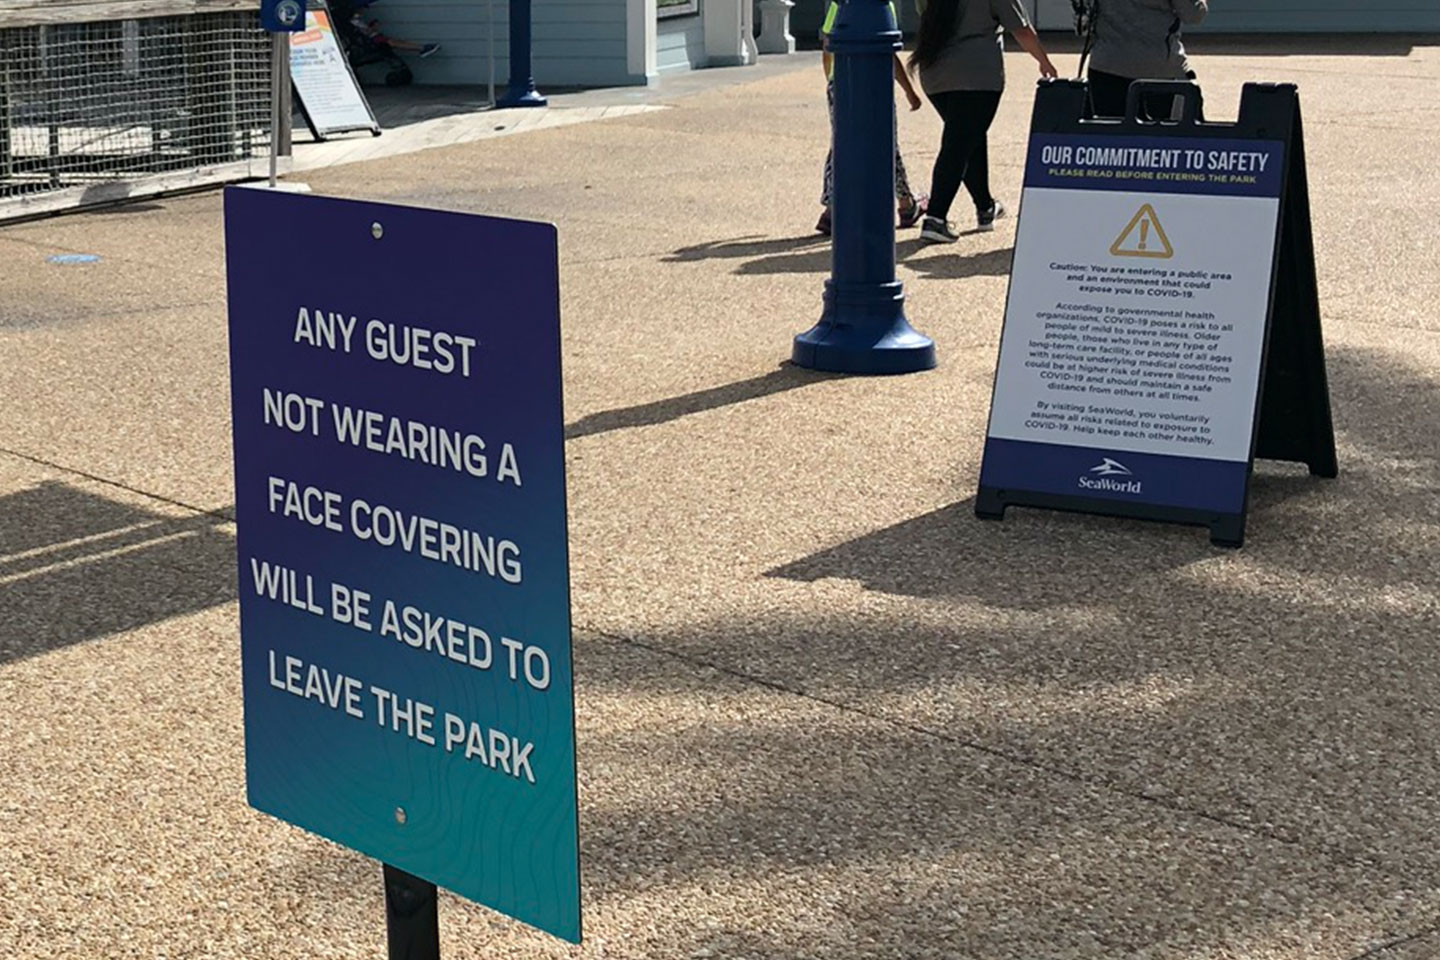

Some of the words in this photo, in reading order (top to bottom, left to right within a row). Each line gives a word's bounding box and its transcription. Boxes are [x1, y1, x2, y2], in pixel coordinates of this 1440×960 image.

[1041, 145, 1072, 164] OUR
[1075, 146, 1182, 168] COMMITMENT
[1184, 150, 1204, 169] TO
[1207, 150, 1269, 172] SAFETY
[1048, 168, 1084, 177] PLEASE
[1086, 169, 1113, 178] READ
[1115, 170, 1154, 179] BEFORE
[1156, 171, 1206, 182] ENTERING
[1208, 173, 1227, 182] THE
[1229, 174, 1256, 183] PARK
[1049, 262, 1087, 271] Caution:
[1090, 265, 1108, 273] You
[1127, 268, 1167, 278] entering
[1177, 270, 1208, 279] public
[1066, 274, 1085, 282] and
[1099, 276, 1160, 286] environment
[1161, 279, 1181, 287] that
[1183, 281, 1211, 289] could
[1078, 285, 1112, 293] expose
[1114, 287, 1132, 295] you
[1134, 287, 1145, 295] to
[1055, 302, 1103, 314] According
[1117, 307, 1183, 318] governmental
[1184, 311, 1215, 320] health
[1044, 322, 1077, 331] people
[1091, 325, 1112, 334] mild
[1114, 327, 1124, 335] to
[1126, 328, 1157, 337] severe
[1193, 331, 1221, 341] Older
[1103, 315, 1148, 326] COVID-19
[1149, 320, 1178, 328] poses
[1188, 322, 1205, 330] risk
[294, 307, 357, 353] ANY
[366, 319, 476, 377] GUEST
[1028, 339, 1075, 350] long-term
[1076, 344, 1097, 352] care
[1147, 350, 1180, 359] people
[1182, 352, 1194, 360] of
[1195, 353, 1207, 361] all
[1209, 355, 1232, 363] ages
[1082, 334, 1108, 343] those
[1110, 336, 1131, 345] who
[1132, 338, 1150, 346] live
[1162, 341, 1180, 350] any
[1182, 342, 1205, 351] type
[1206, 343, 1218, 351] of
[1024, 360, 1051, 369] could
[1052, 362, 1065, 370] be
[1066, 363, 1076, 371] at
[1078, 364, 1109, 374] higher
[1130, 368, 1141, 376] of
[1142, 370, 1174, 379] severe
[1175, 372, 1205, 381] illness
[1208, 374, 1231, 383] from
[1051, 353, 1084, 362] serious
[1086, 356, 1137, 367] underlying
[1138, 360, 1177, 369] medical
[1178, 363, 1229, 373] conditions
[1039, 370, 1084, 382] COVID-19
[1106, 377, 1138, 386] should
[1139, 380, 1182, 390] maintain
[1192, 384, 1212, 392] safe
[1047, 382, 1086, 392] distance
[1088, 384, 1111, 394] from
[1113, 388, 1143, 397] others
[1158, 391, 1170, 399] all
[1030, 411, 1065, 421] assume
[1080, 415, 1102, 424] risks
[1104, 417, 1139, 428] related
[1140, 421, 1151, 429] to
[1153, 423, 1198, 433] exposure
[1199, 426, 1211, 434] to
[1036, 400, 1050, 410] By
[1051, 403, 1085, 413] visiting
[1158, 412, 1210, 425] voluntarily
[263, 388, 324, 436] NOT
[331, 403, 488, 477] WEARING
[497, 443, 522, 486] A
[1073, 425, 1095, 434] Help
[1097, 426, 1121, 437] keep
[1122, 430, 1146, 438] each
[1147, 432, 1174, 441] other
[1078, 476, 1141, 493] SeaWorld
[268, 476, 343, 532] FACE
[351, 499, 522, 583] COVERING
[251, 557, 324, 615] WILL
[331, 583, 372, 631] BE
[380, 600, 492, 669] ASKED
[501, 637, 550, 689] TO
[269, 650, 364, 718] LEAVE
[370, 686, 435, 745] THE
[445, 712, 535, 783] PARK
